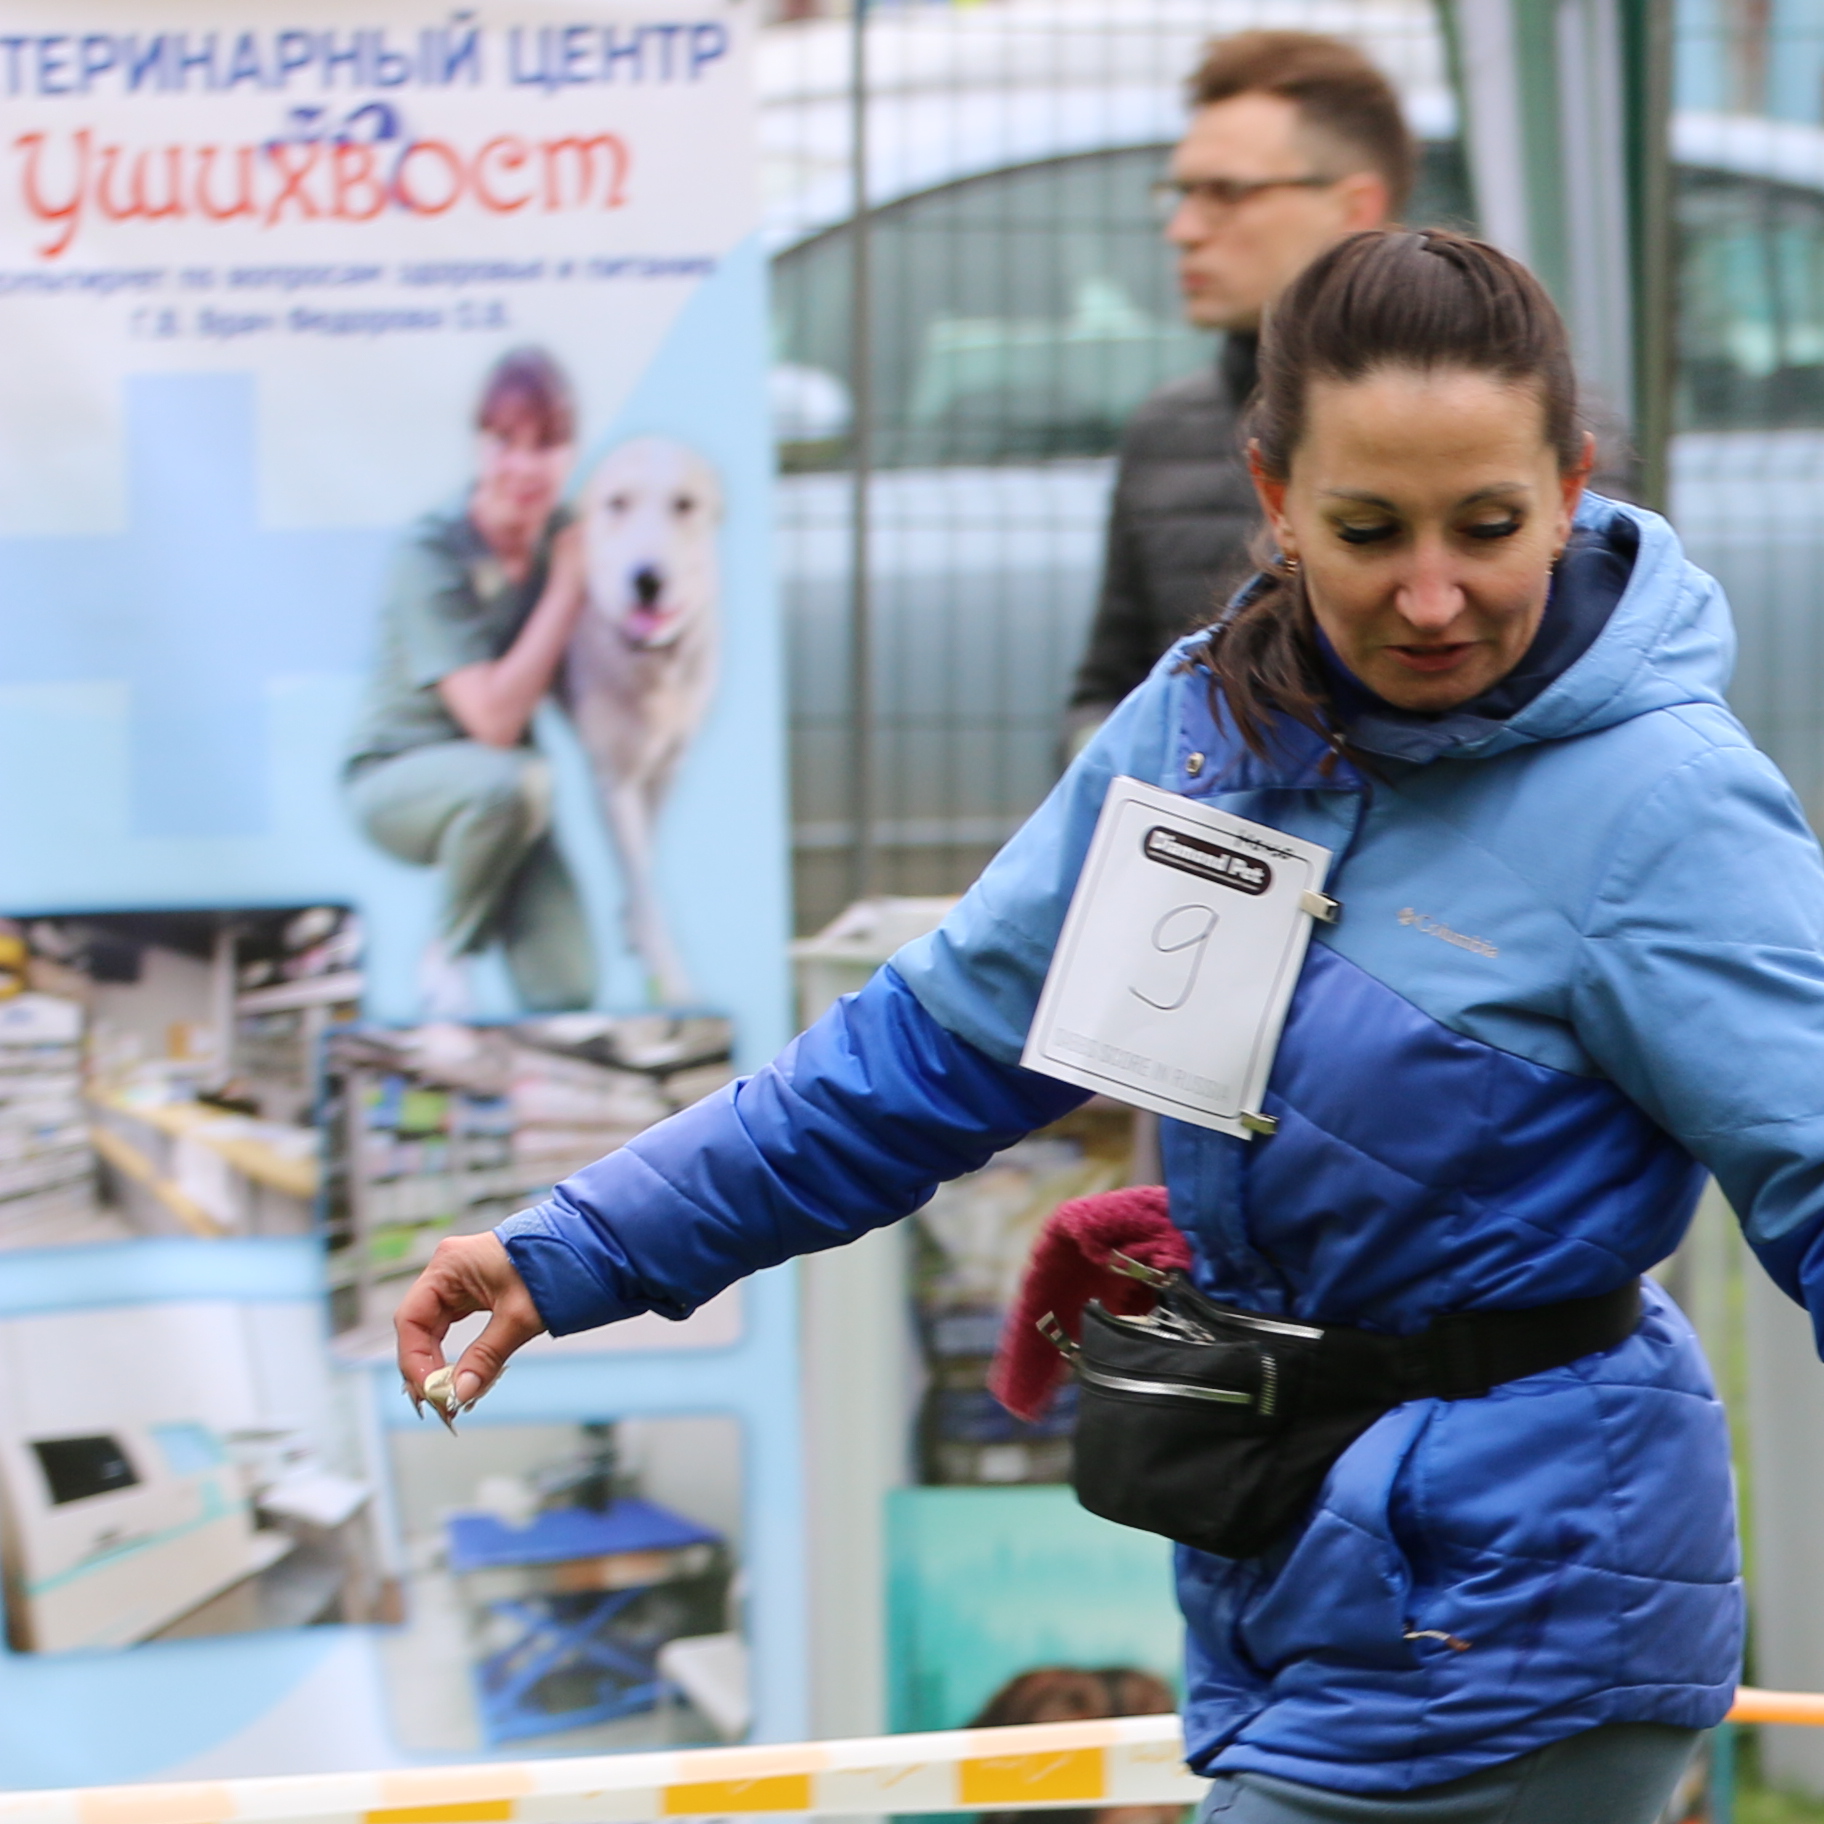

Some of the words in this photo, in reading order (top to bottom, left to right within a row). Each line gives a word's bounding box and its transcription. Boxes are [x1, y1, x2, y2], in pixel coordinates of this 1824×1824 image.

[0, 10, 482, 95] ТЕРИНАРНЫЙ
[508, 22, 731, 96] ЦЕНТР
[1149, 829, 1231, 873] Diamond
[1229, 856, 1266, 885] Pet
[1097, 1042, 1153, 1077] SCORE
[1150, 1061, 1173, 1083] IN
[1170, 1067, 1232, 1104] RUSSIA
